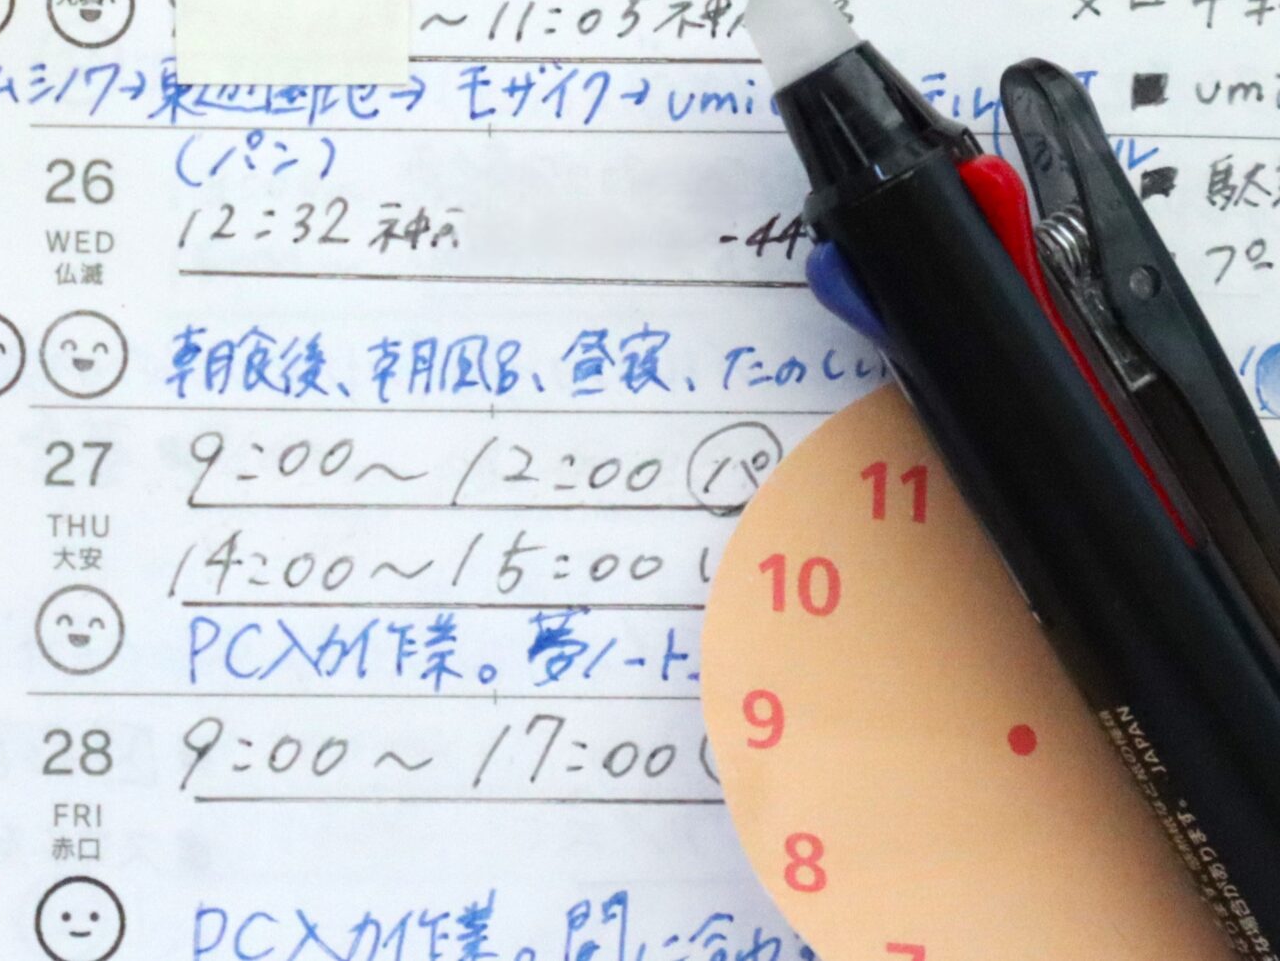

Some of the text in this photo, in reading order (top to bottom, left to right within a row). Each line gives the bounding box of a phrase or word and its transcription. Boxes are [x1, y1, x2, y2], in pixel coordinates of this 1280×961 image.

[45, 158, 116, 204] 26
[45, 230, 115, 255] WED
[54, 262, 105, 286] 仏滅
[44, 440, 114, 487] 27
[860, 460, 928, 524] 11
[47, 513, 110, 538] THU
[53, 546, 104, 571] 大安
[758, 553, 842, 617] 10
[742, 689, 786, 750] 9
[1116, 705, 1167, 774] JAPAN
[42, 728, 114, 776] 28
[53, 803, 102, 828] FRI
[51, 837, 101, 862] 赤口
[783, 832, 828, 894] 8
